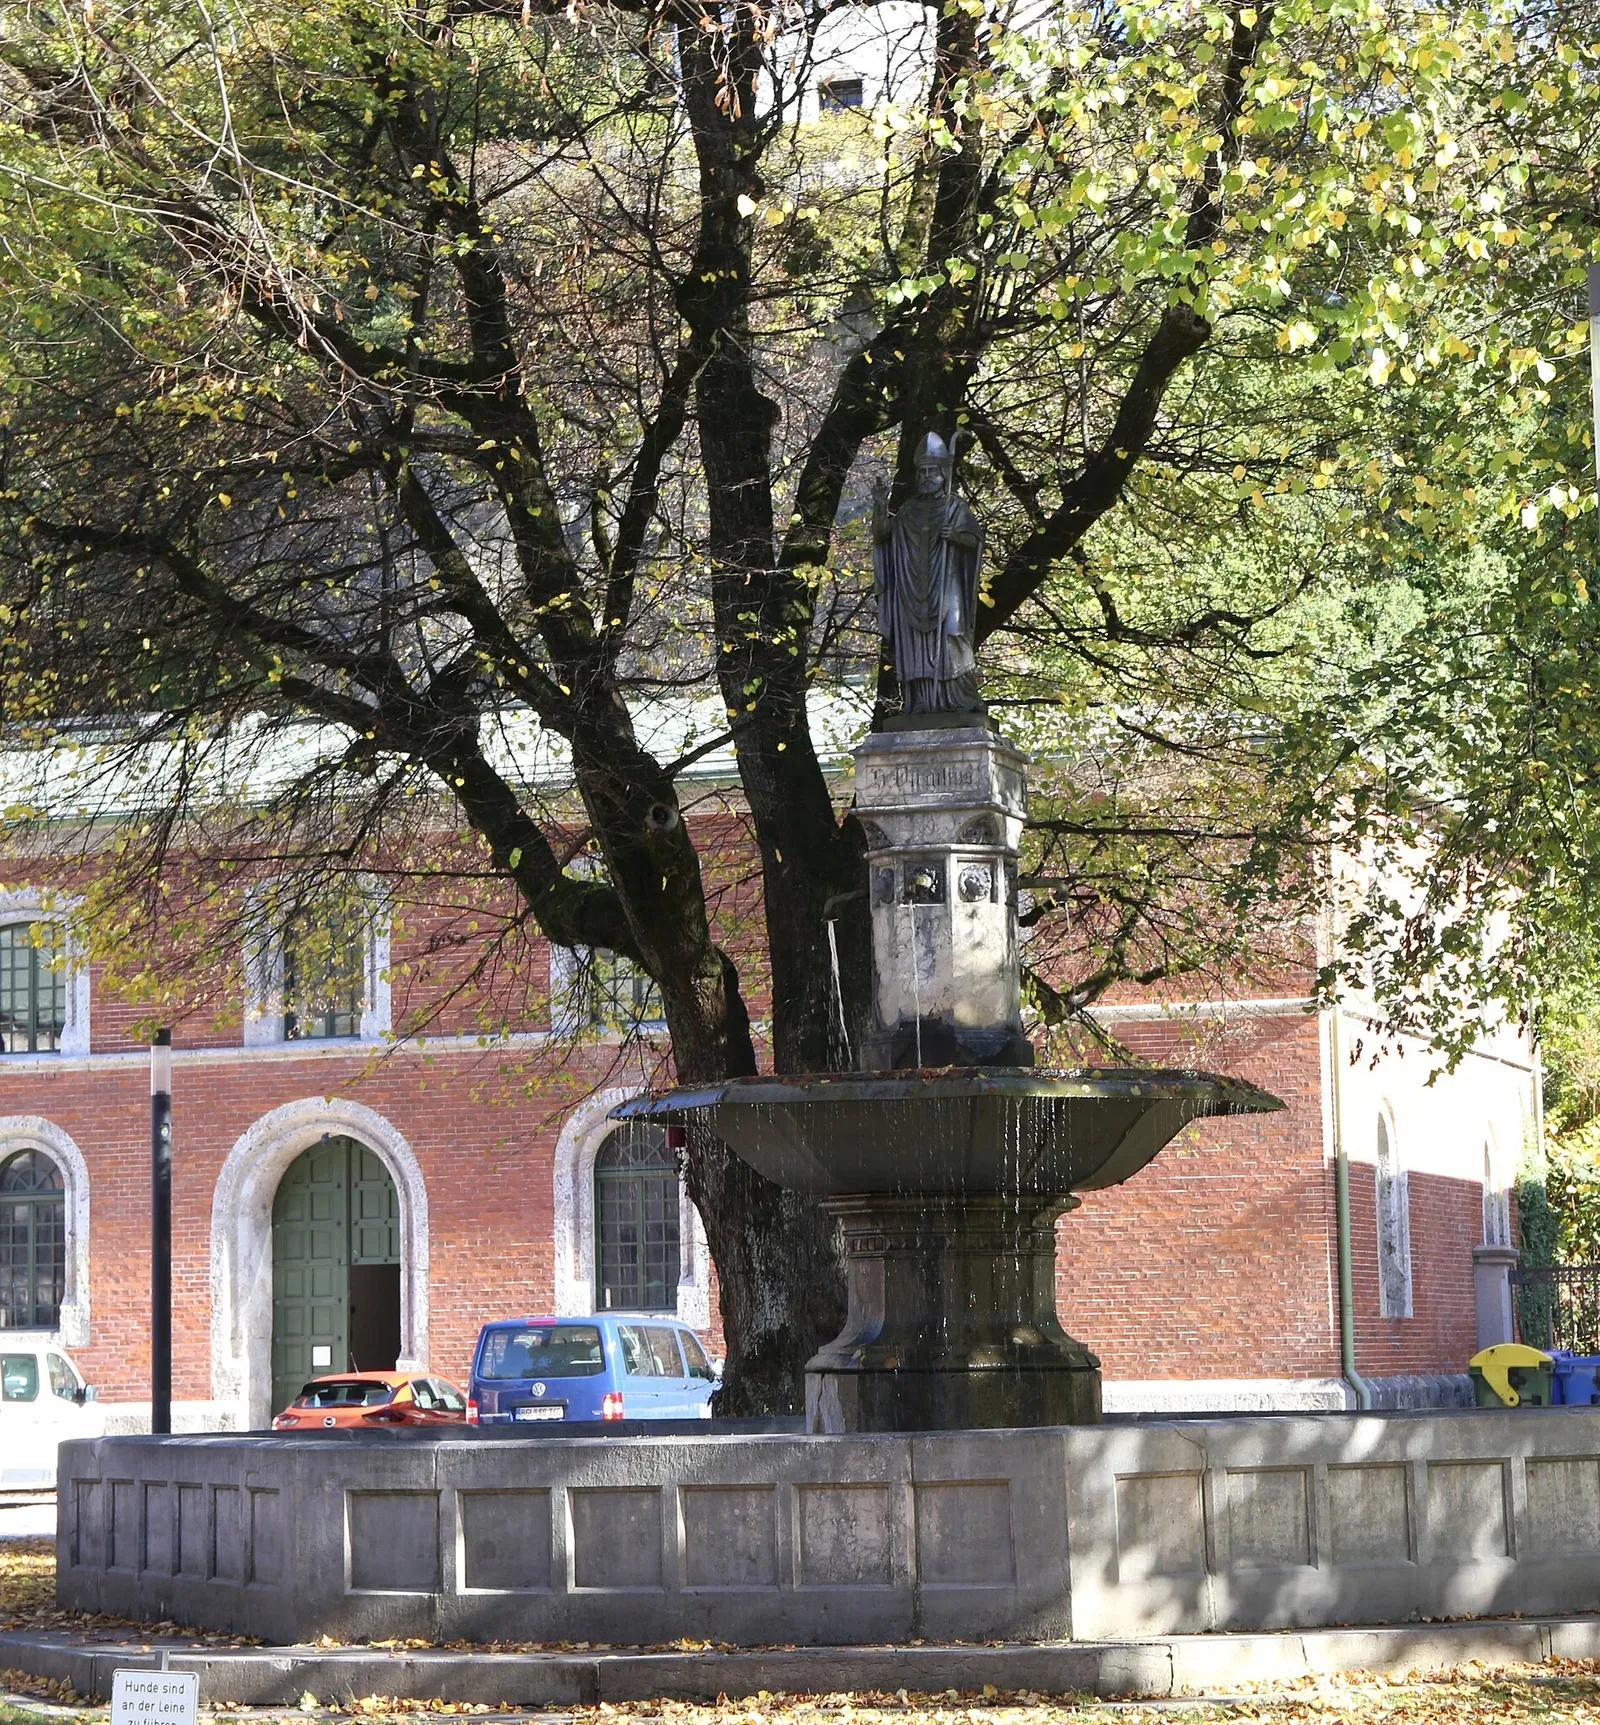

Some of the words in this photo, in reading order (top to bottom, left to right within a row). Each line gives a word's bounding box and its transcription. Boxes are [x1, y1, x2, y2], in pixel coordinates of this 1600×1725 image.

[125, 1681, 159, 1693] Hunde
[163, 1682, 185, 1694] sind
[122, 1701, 134, 1710] an
[138, 1700, 155, 1711] der
[159, 1701, 185, 1713] Leine
